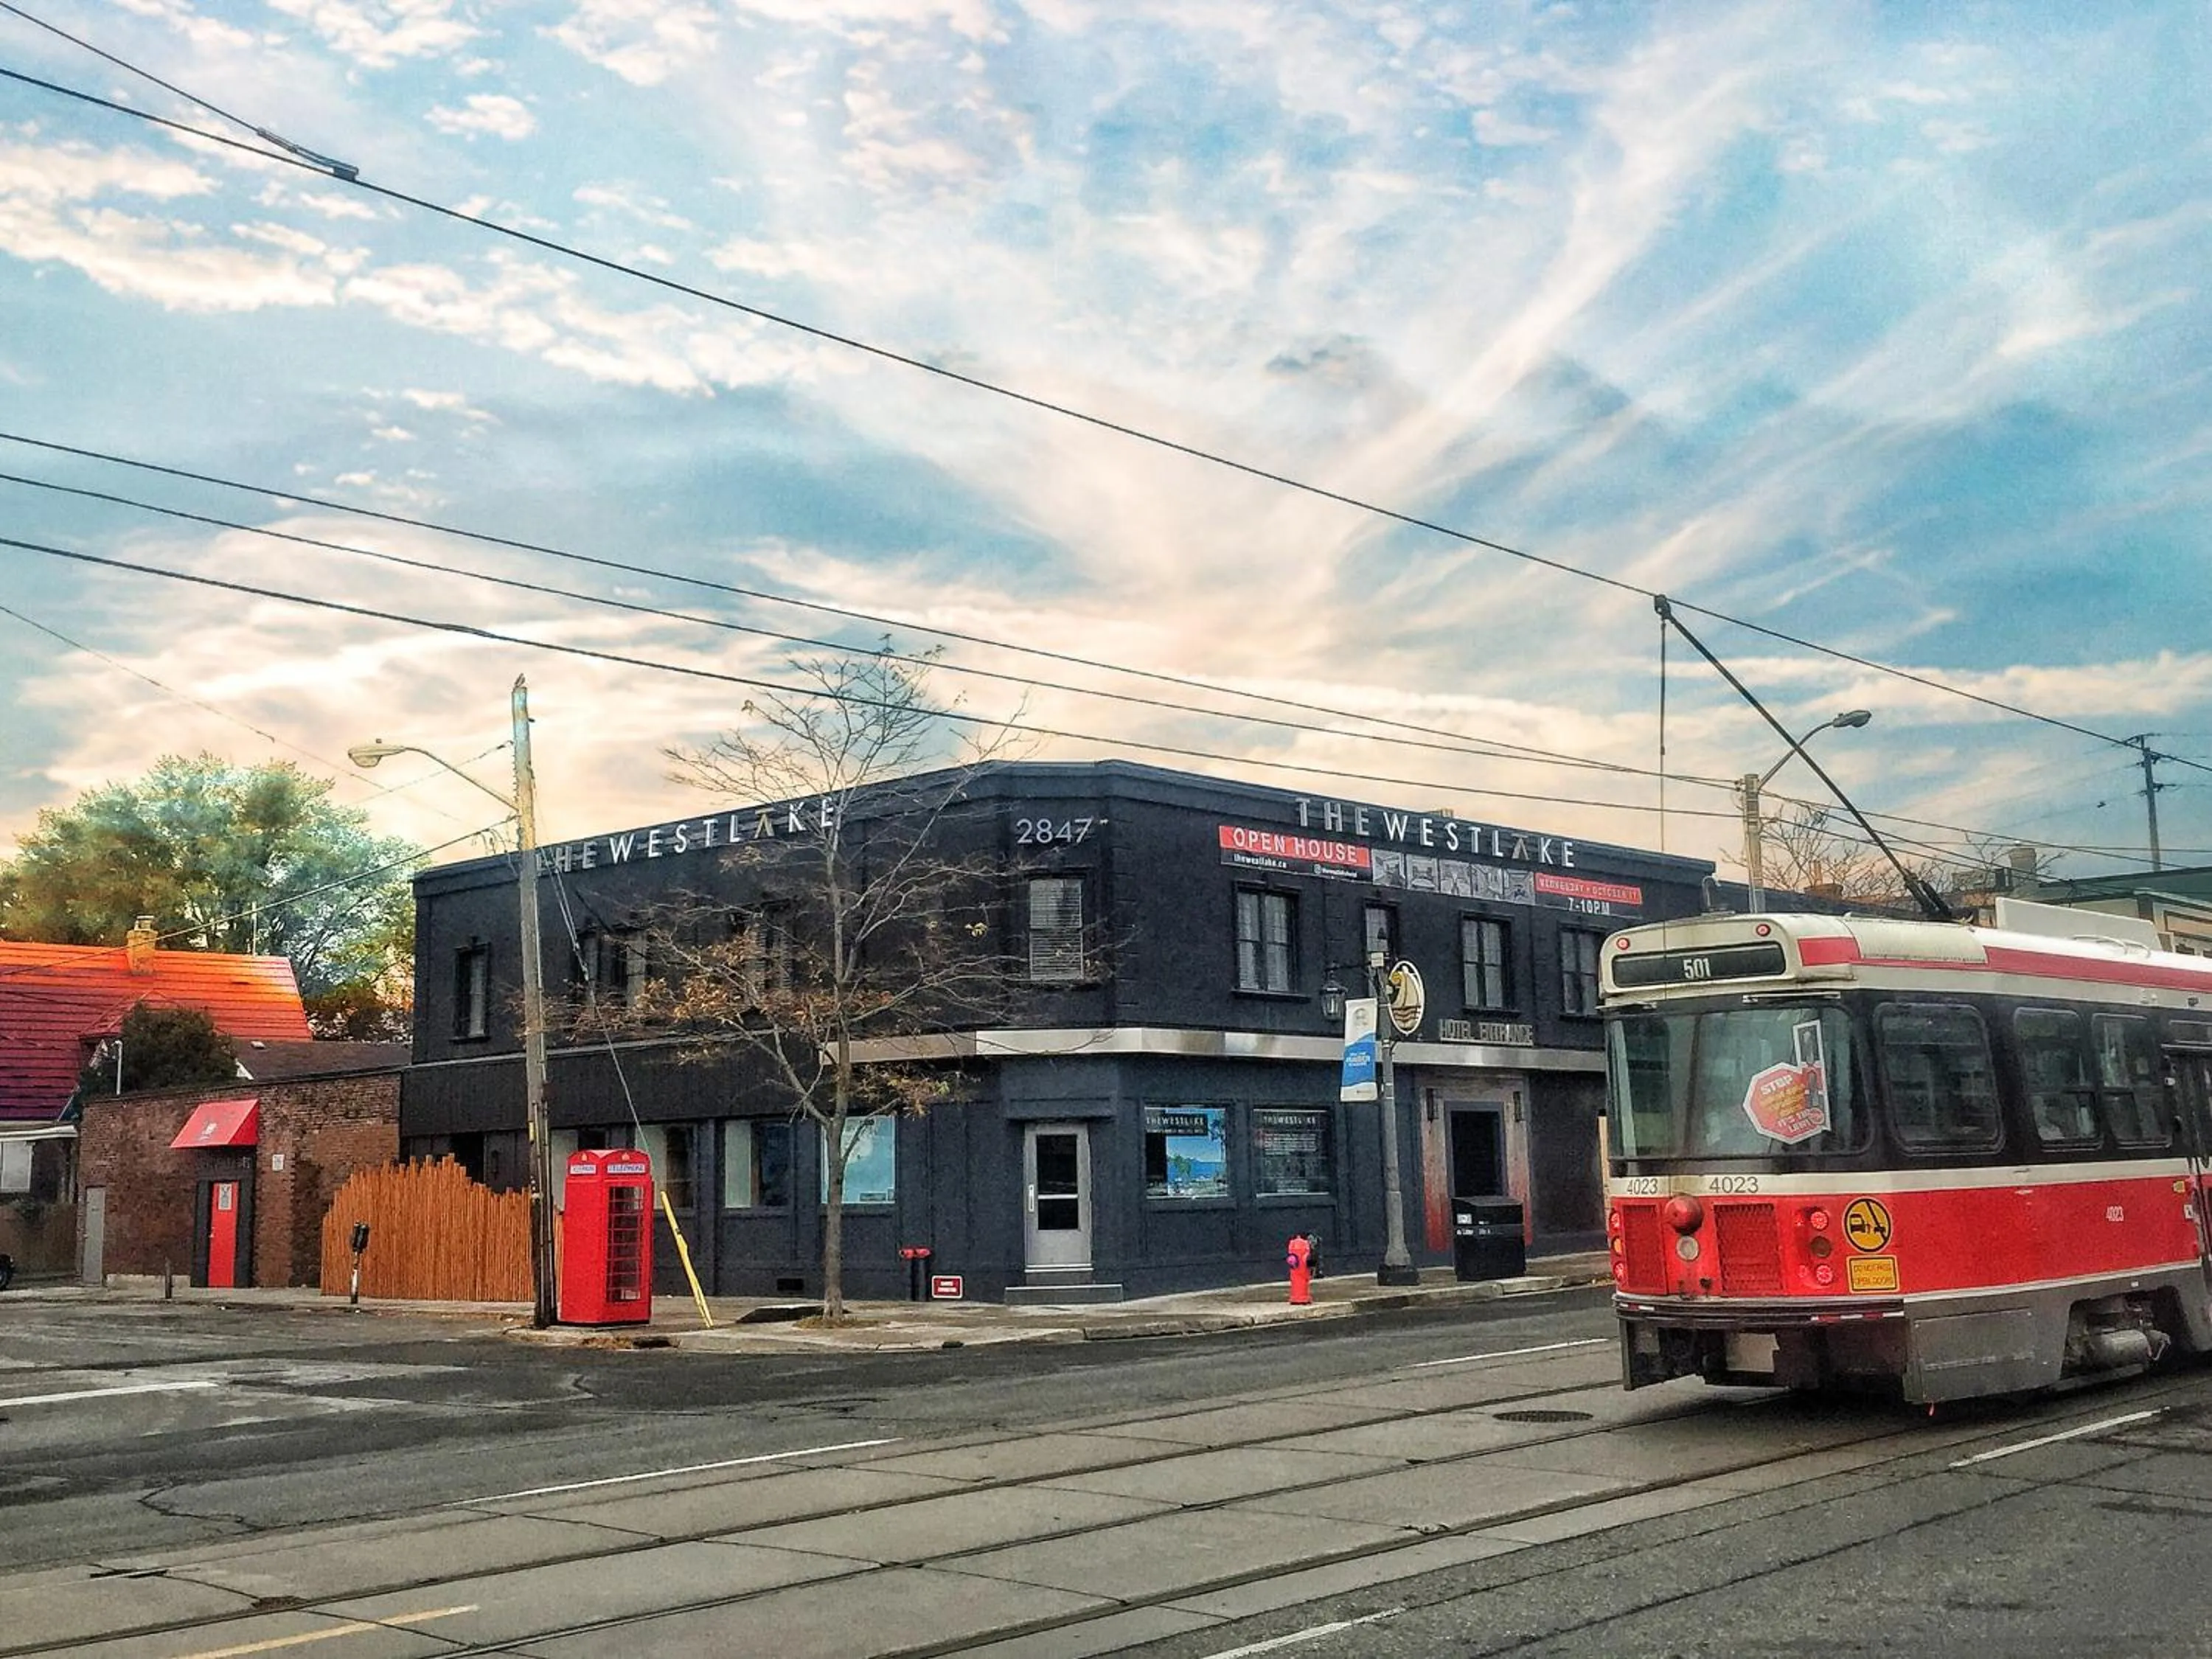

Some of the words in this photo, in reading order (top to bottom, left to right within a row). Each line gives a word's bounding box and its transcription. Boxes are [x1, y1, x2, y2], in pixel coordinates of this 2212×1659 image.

[609, 796, 835, 864] WESTLAKE
[1016, 817, 1094, 844] 2847
[1295, 798, 1370, 836] THE
[1383, 811, 1575, 868] WESTLAKE
[1233, 827, 1285, 853] OPEN
[1293, 837, 1357, 863] HOUSE
[1683, 958, 1711, 979] 501
[1760, 1074, 1793, 1095] STOP
[1626, 1178, 1658, 1195] 4023
[1709, 1175, 1759, 1194] 4023
